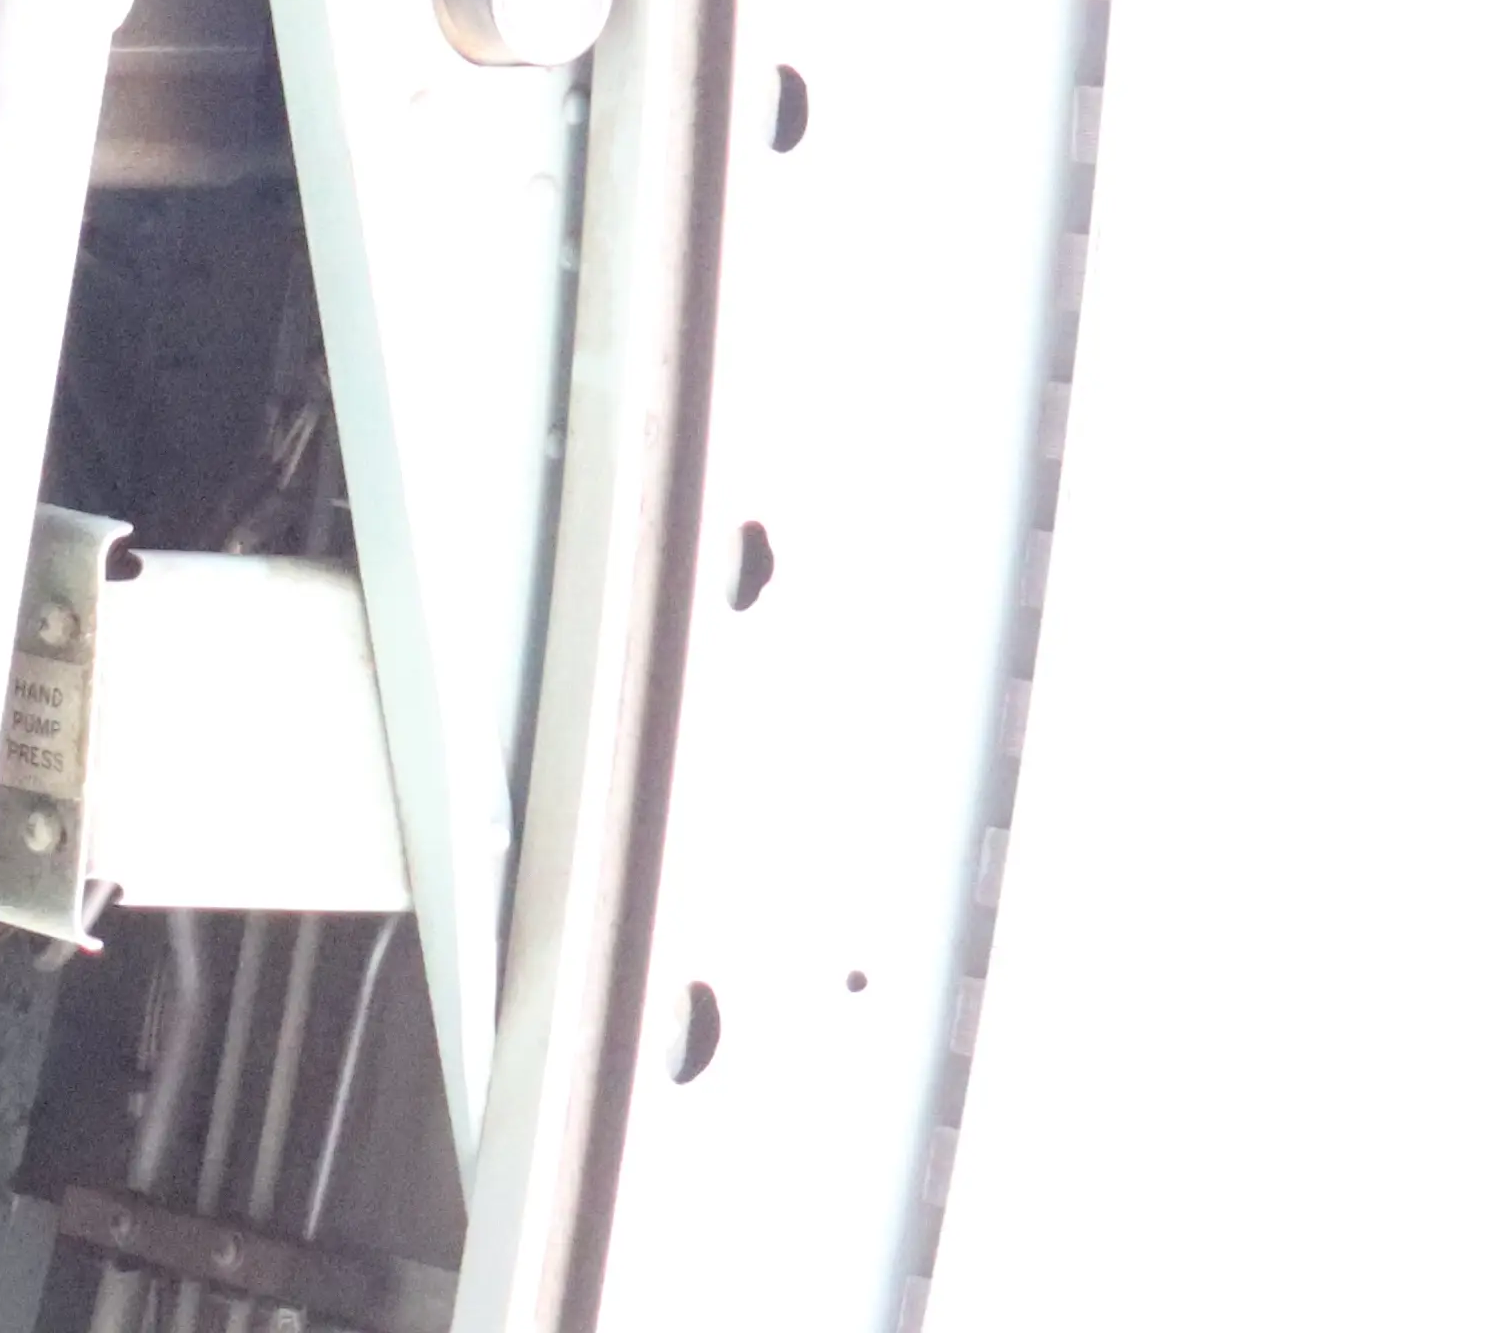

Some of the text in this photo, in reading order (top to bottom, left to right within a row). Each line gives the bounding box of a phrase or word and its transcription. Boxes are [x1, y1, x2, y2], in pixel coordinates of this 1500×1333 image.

[14, 677, 63, 708] HAND
[12, 711, 61, 738] PUMP
[6, 737, 63, 774] PRESS
